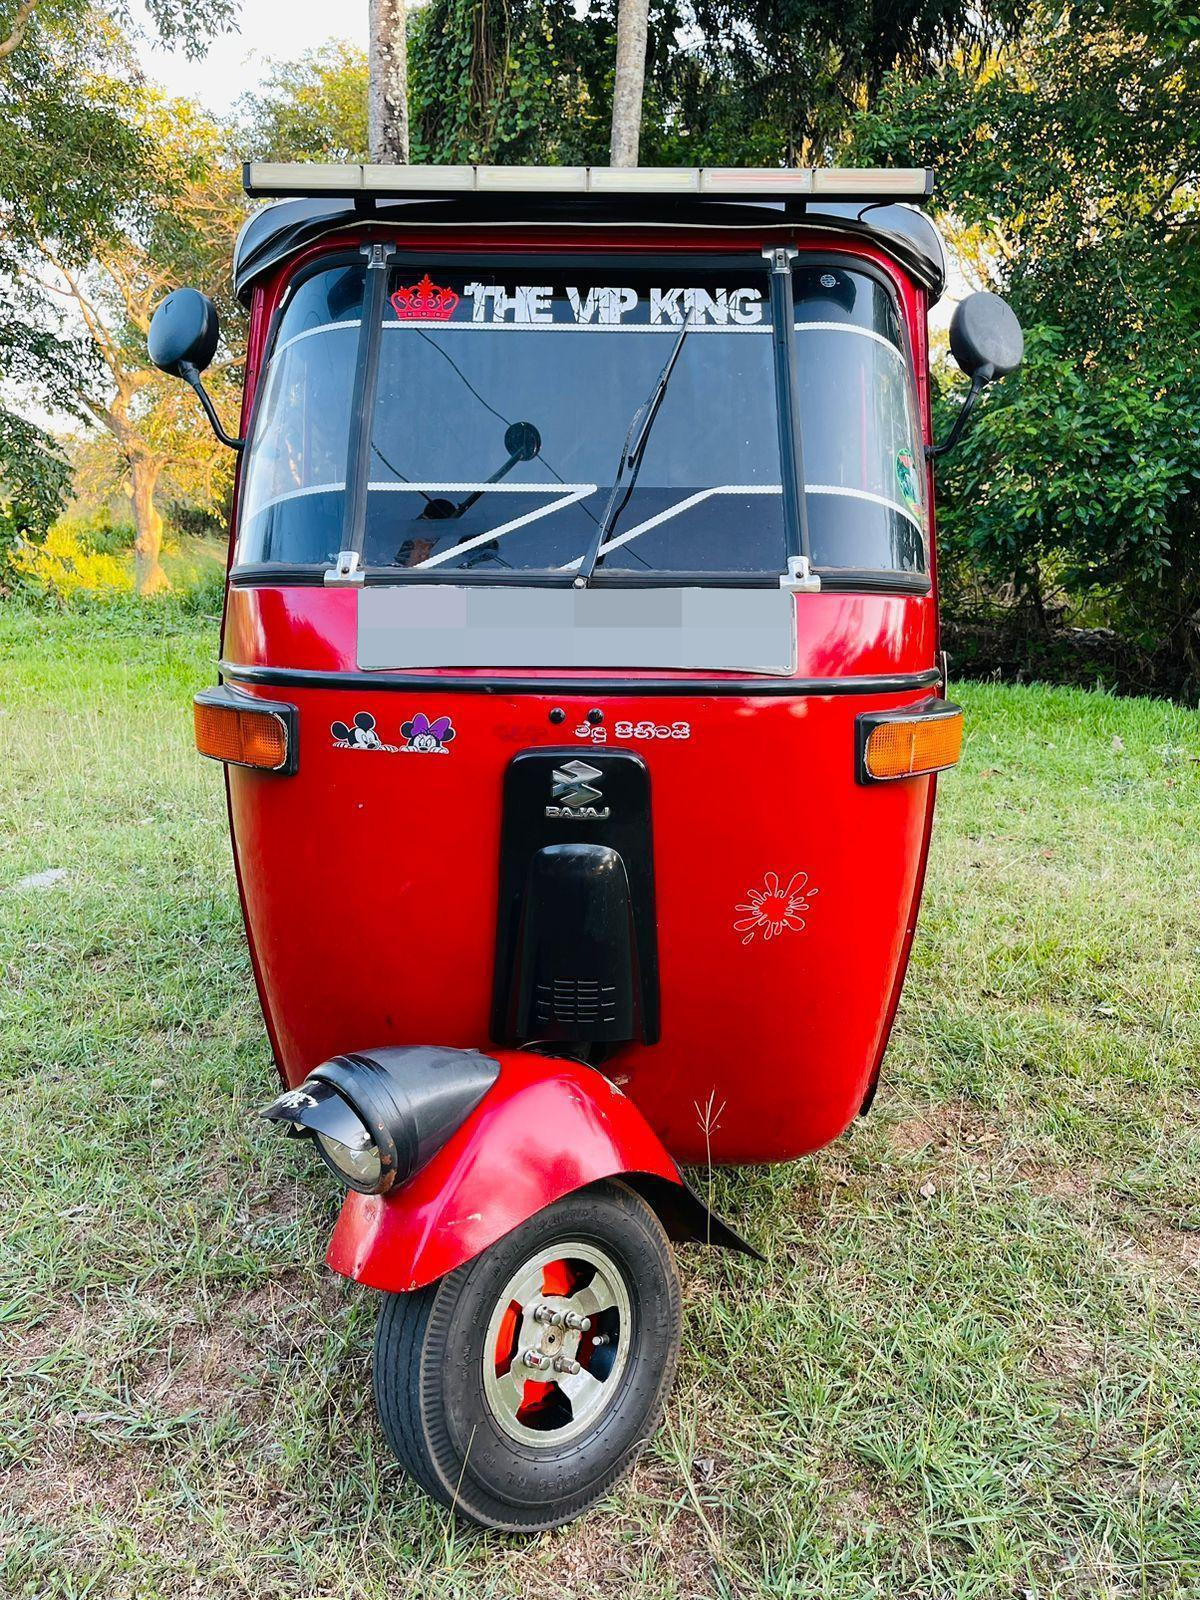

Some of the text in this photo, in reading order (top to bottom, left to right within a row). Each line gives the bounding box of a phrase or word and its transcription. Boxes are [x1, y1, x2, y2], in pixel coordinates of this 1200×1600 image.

[464, 282, 763, 325] THE VIP KING
[545, 806, 610, 818] BAJAJ
